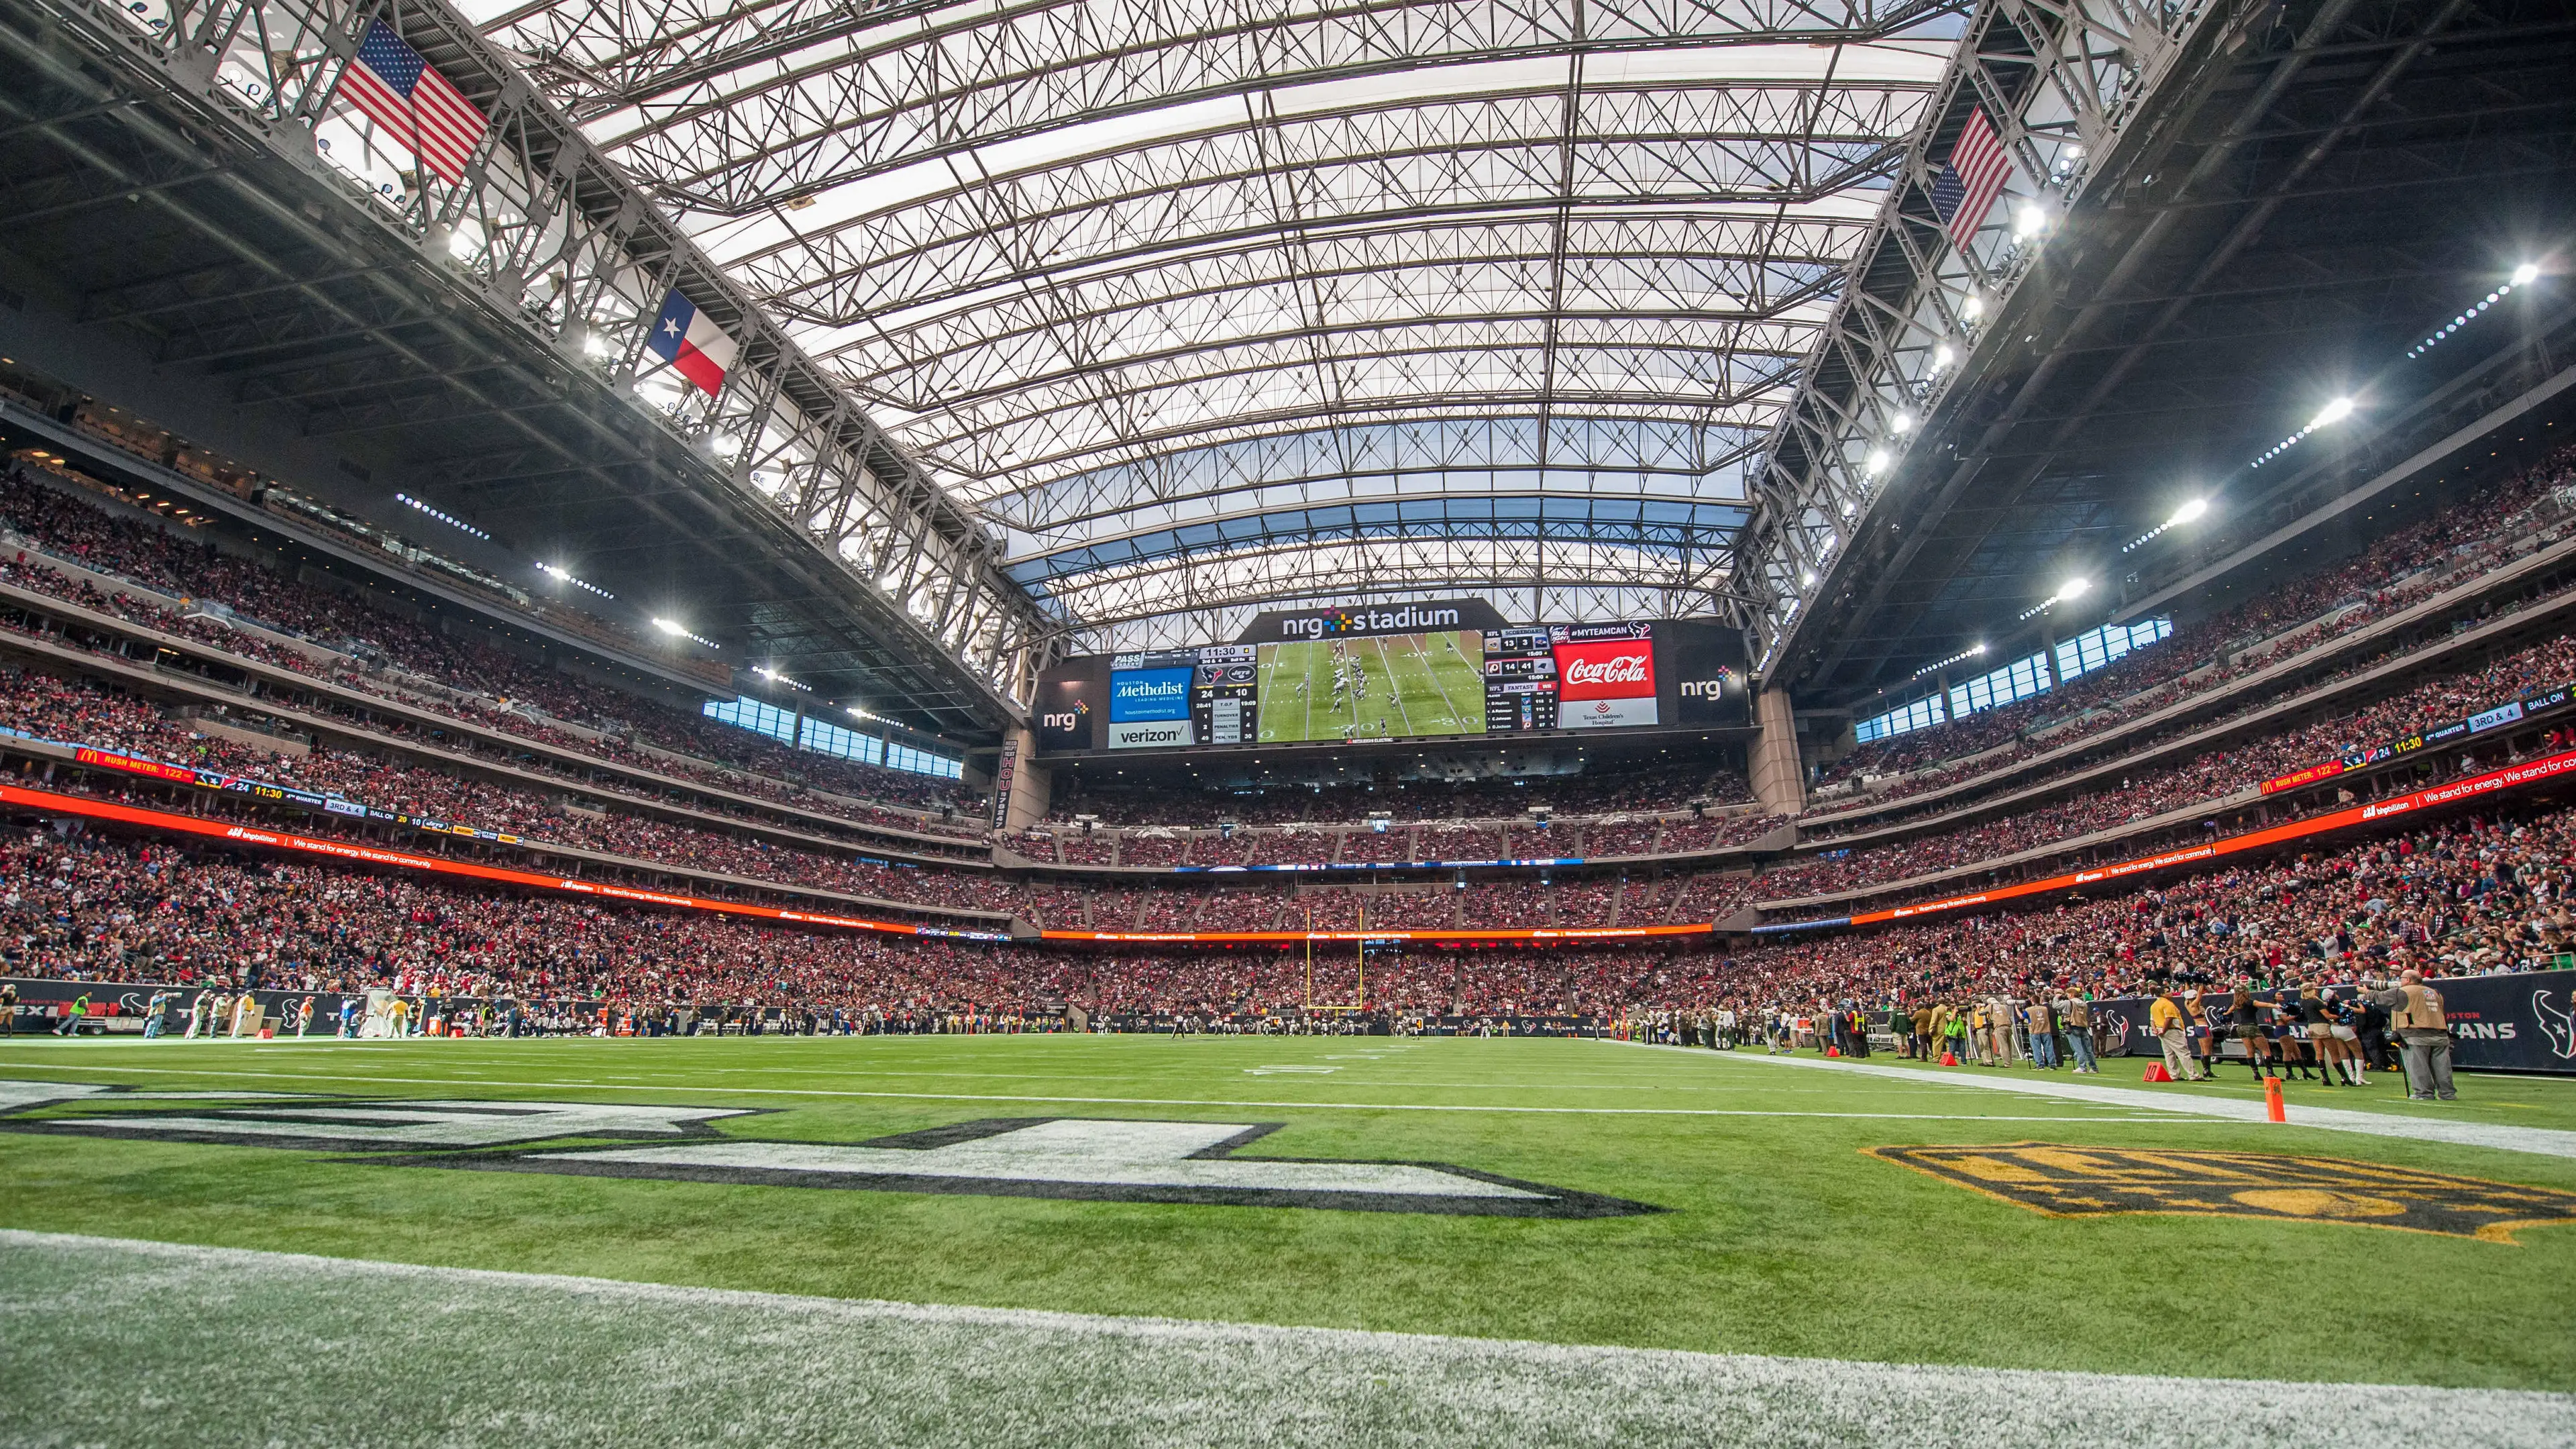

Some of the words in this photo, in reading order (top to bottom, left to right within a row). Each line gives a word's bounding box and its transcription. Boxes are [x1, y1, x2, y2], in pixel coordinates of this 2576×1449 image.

[1283, 617, 1323, 639] nrg
[1353, 606, 1459, 631] stadium
[1572, 626, 1627, 637] #MYTEAMCAN
[1114, 655, 1140, 663] PASS
[1206, 647, 1236, 656] 11:30
[1566, 655, 1648, 684] Coca-Cola
[1117, 682, 1183, 697] Methodist
[1201, 690, 1214, 698] 24
[1236, 688, 1248, 696] 10
[1680, 680, 1721, 701] nrg
[2475, 716, 2493, 728] 3RD
[2496, 712, 2504, 720] &
[2507, 708, 2514, 717] 4
[2528, 698, 2550, 711] BALL
[2550, 692, 2566, 703] ON
[1044, 712, 1075, 731] nrg
[1120, 729, 1177, 743] verizon
[2378, 747, 2391, 759] 24
[2394, 736, 2423, 753] 11:30
[2435, 724, 2465, 738] QUARTER
[104, 755, 128, 767] RUSH
[129, 761, 159, 773] METER:
[164, 768, 182, 779] 122
[2275, 777, 2292, 788] RUSH
[2292, 771, 2314, 783] METER:
[2316, 765, 2332, 776] 122
[2424, 793, 2438, 802] We
[2439, 786, 2461, 800] stand
[2461, 784, 2473, 794] for
[2474, 777, 2504, 788] energy.
[2504, 771, 2521, 783] We
[2522, 763, 2547, 779] stand
[2548, 761, 2561, 771] for
[236, 782, 250, 792] 24
[255, 786, 282, 799] 11:30
[295, 795, 322, 805] QUARTER
[330, 802, 344, 811] 3RD
[370, 810, 384, 818] BALL
[397, 815, 407, 823] 20
[294, 839, 306, 847] We
[307, 842, 326, 851] stand
[327, 845, 336, 853] for
[360, 850, 371, 858] We
[372, 853, 390, 861] stand
[2119, 865, 2131, 873] stand
[2163, 855, 2177, 864] stand
[2145, 1065, 2157, 1080] 10
